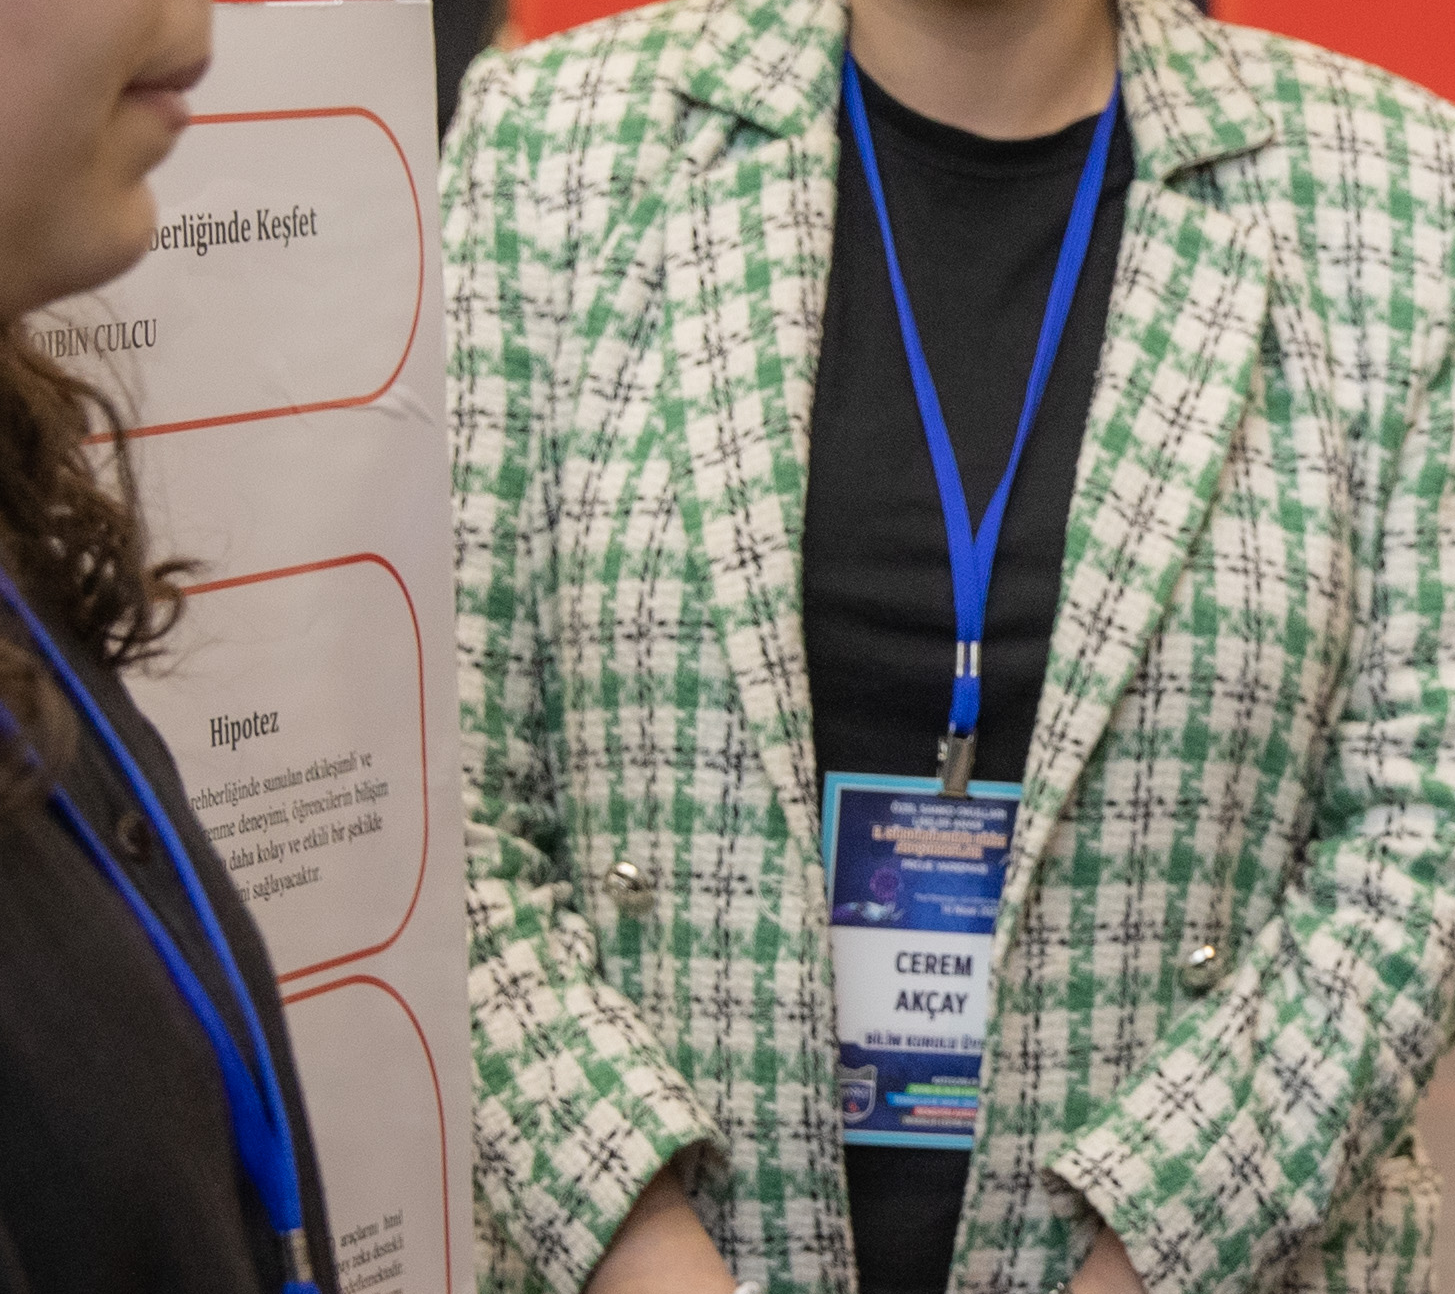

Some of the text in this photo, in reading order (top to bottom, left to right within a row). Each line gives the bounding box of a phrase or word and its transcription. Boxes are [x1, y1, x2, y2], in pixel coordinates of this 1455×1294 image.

[256, 205, 318, 248] Keşfet
[94, 318, 157, 361] ÇULCU
[209, 711, 280, 750] Hipotez
[263, 768, 303, 793] sunulan
[359, 752, 373, 768] ve
[291, 787, 352, 824] öğrencilerin
[229, 848, 254, 871] daha
[256, 839, 286, 864] kolay
[288, 839, 301, 854] ve
[331, 821, 345, 843] bir
[348, 811, 383, 843] şekilde
[896, 951, 974, 977] CEREM
[895, 989, 969, 1021] AKÇAY
